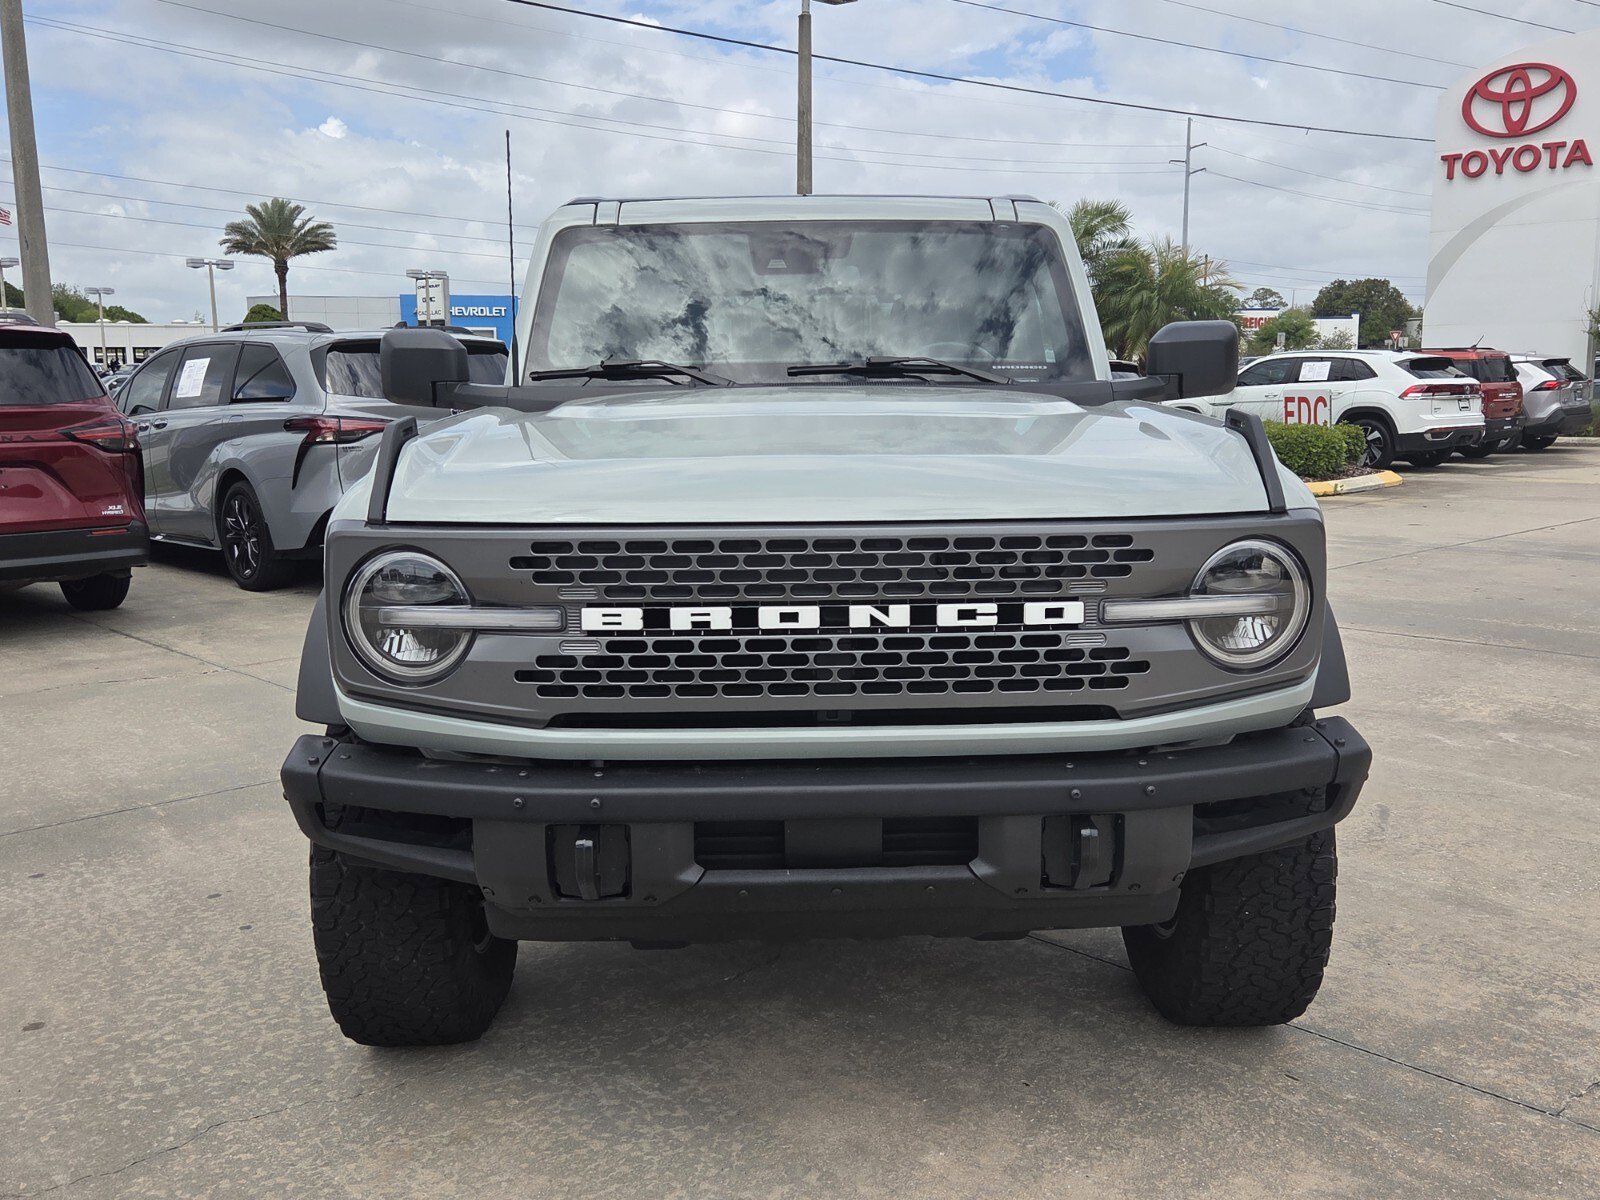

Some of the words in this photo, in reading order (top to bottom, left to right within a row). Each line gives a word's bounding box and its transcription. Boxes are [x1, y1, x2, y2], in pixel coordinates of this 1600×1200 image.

[1440, 139, 1594, 181] TOYOTA
[449, 306, 507, 317] HEVROLET
[581, 601, 1085, 631] BRONCO
